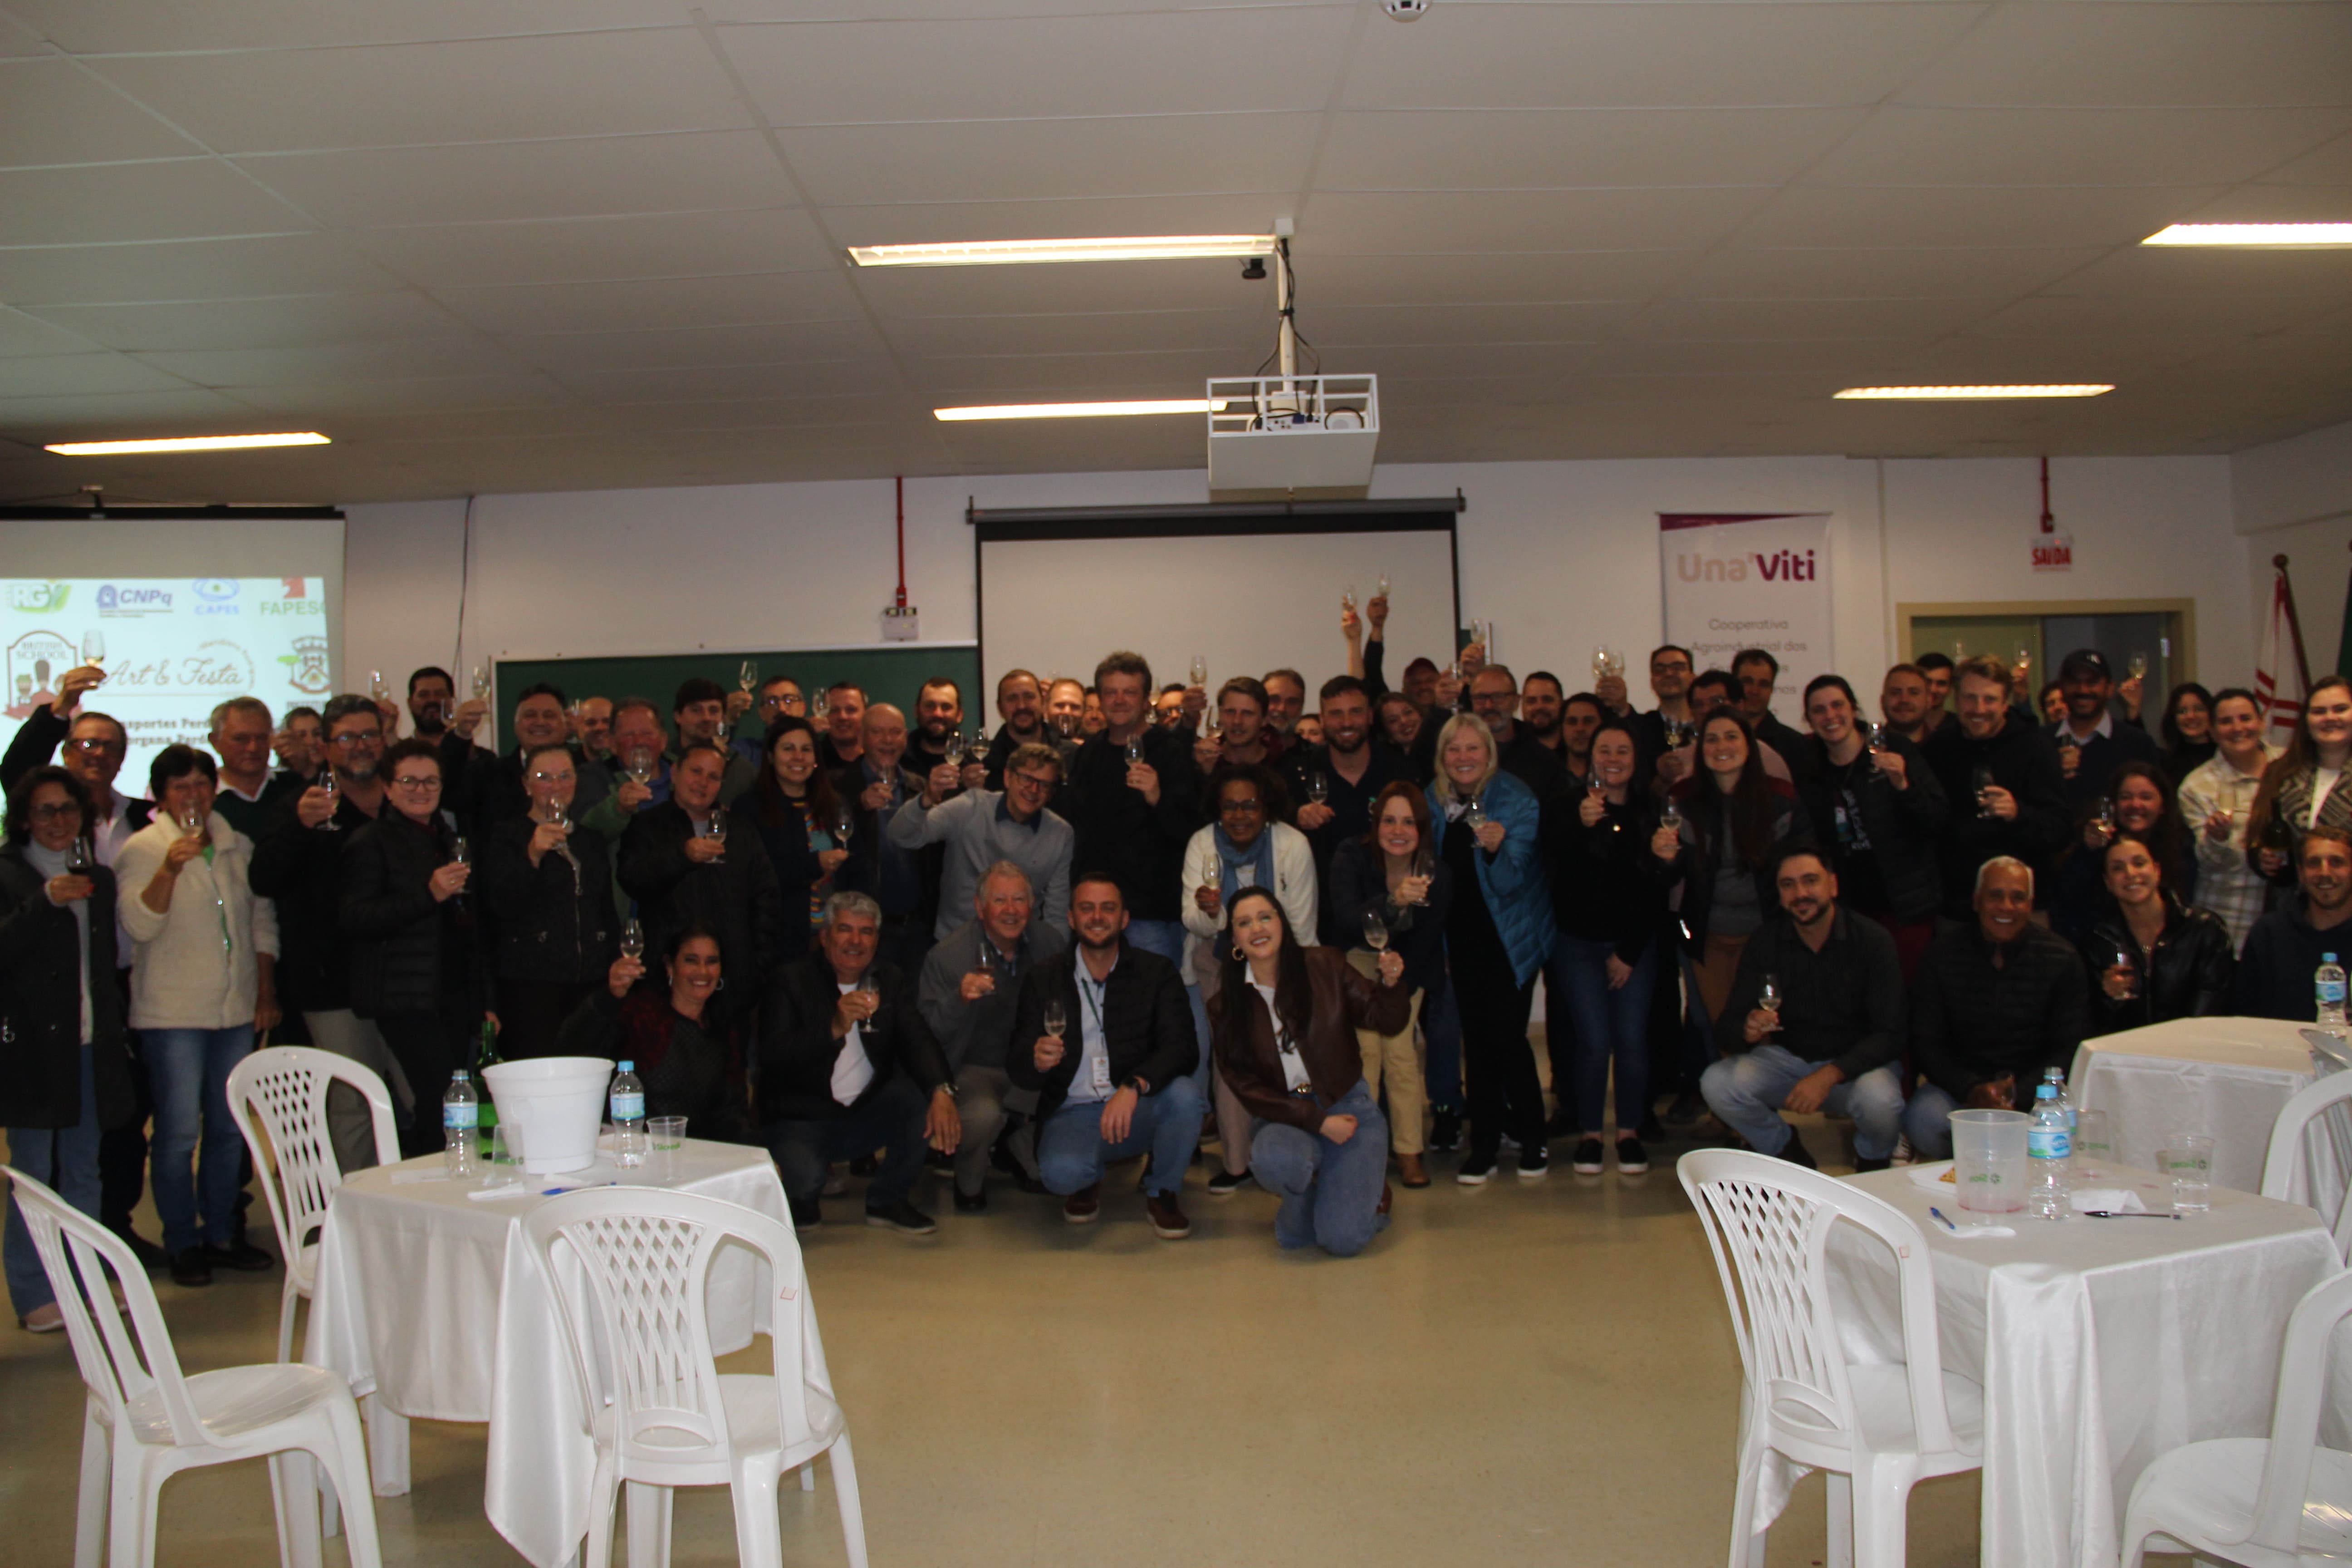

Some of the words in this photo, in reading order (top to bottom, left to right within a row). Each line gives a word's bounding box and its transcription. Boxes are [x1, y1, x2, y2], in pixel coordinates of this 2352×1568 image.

[121, 589, 172, 607] CNPq
[1708, 618, 1788, 632] Cooperativa
[1784, 641, 1808, 652] dos
[16, 651, 68, 660] SCHOOL
[103, 659, 155, 686] Art
[177, 657, 244, 686] Festa
